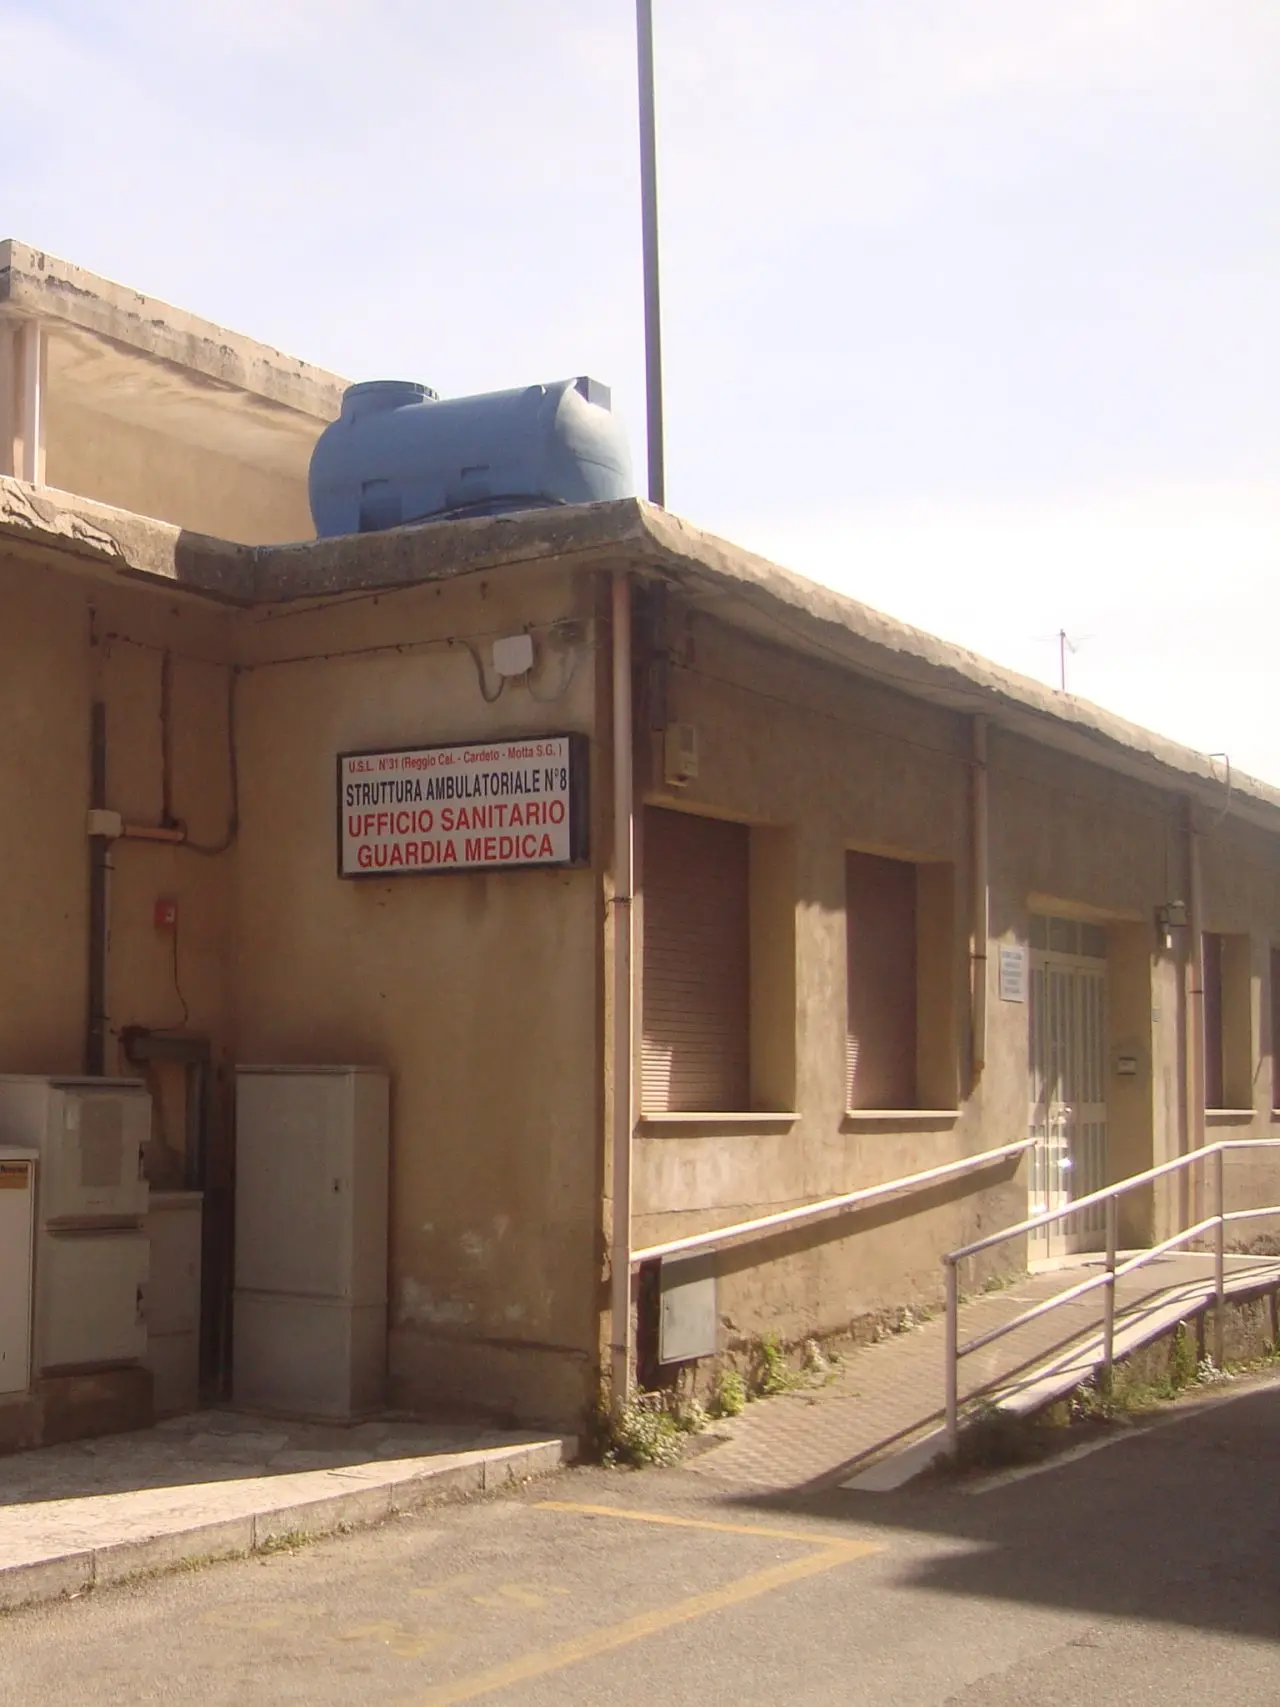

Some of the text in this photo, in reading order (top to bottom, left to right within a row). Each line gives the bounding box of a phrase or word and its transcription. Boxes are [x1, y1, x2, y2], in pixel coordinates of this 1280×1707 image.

[349, 760, 374, 774] U.S.L.
[401, 754, 436, 771] (Reggio
[463, 749, 500, 764] Cardeto
[507, 747, 533, 760] Motta
[346, 777, 422, 807] STRUTTURA
[426, 769, 540, 801] AMBULATORIALE
[348, 800, 565, 838] UFFICIO SANITARIO
[357, 833, 554, 868] GUARDIA MEDICA
